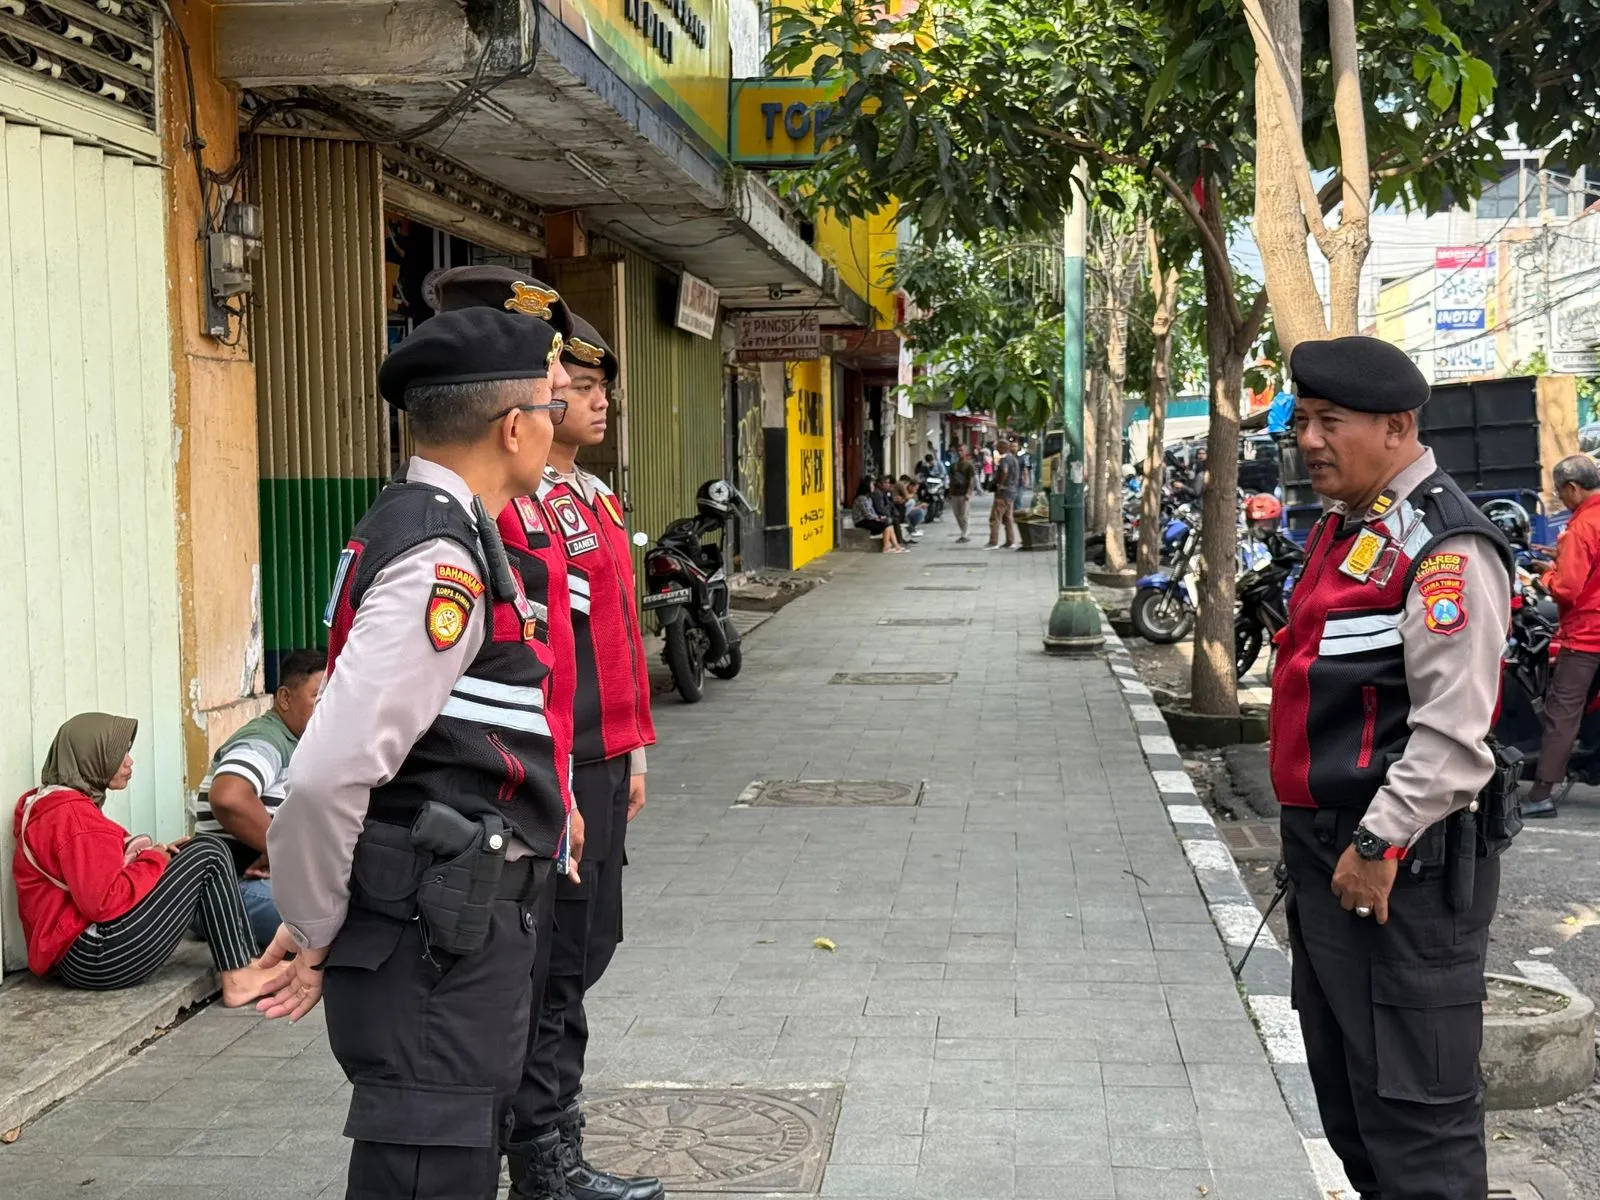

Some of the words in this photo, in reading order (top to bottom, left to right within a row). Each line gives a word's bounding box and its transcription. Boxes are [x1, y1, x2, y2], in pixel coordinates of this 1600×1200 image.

[753, 319, 796, 332] PANGSIT
[1416, 555, 1460, 576] OLRES
[1441, 563, 1460, 571] KOTA
[439, 566, 483, 593] BAHARKAM
[1423, 581, 1440, 593] JAWA
